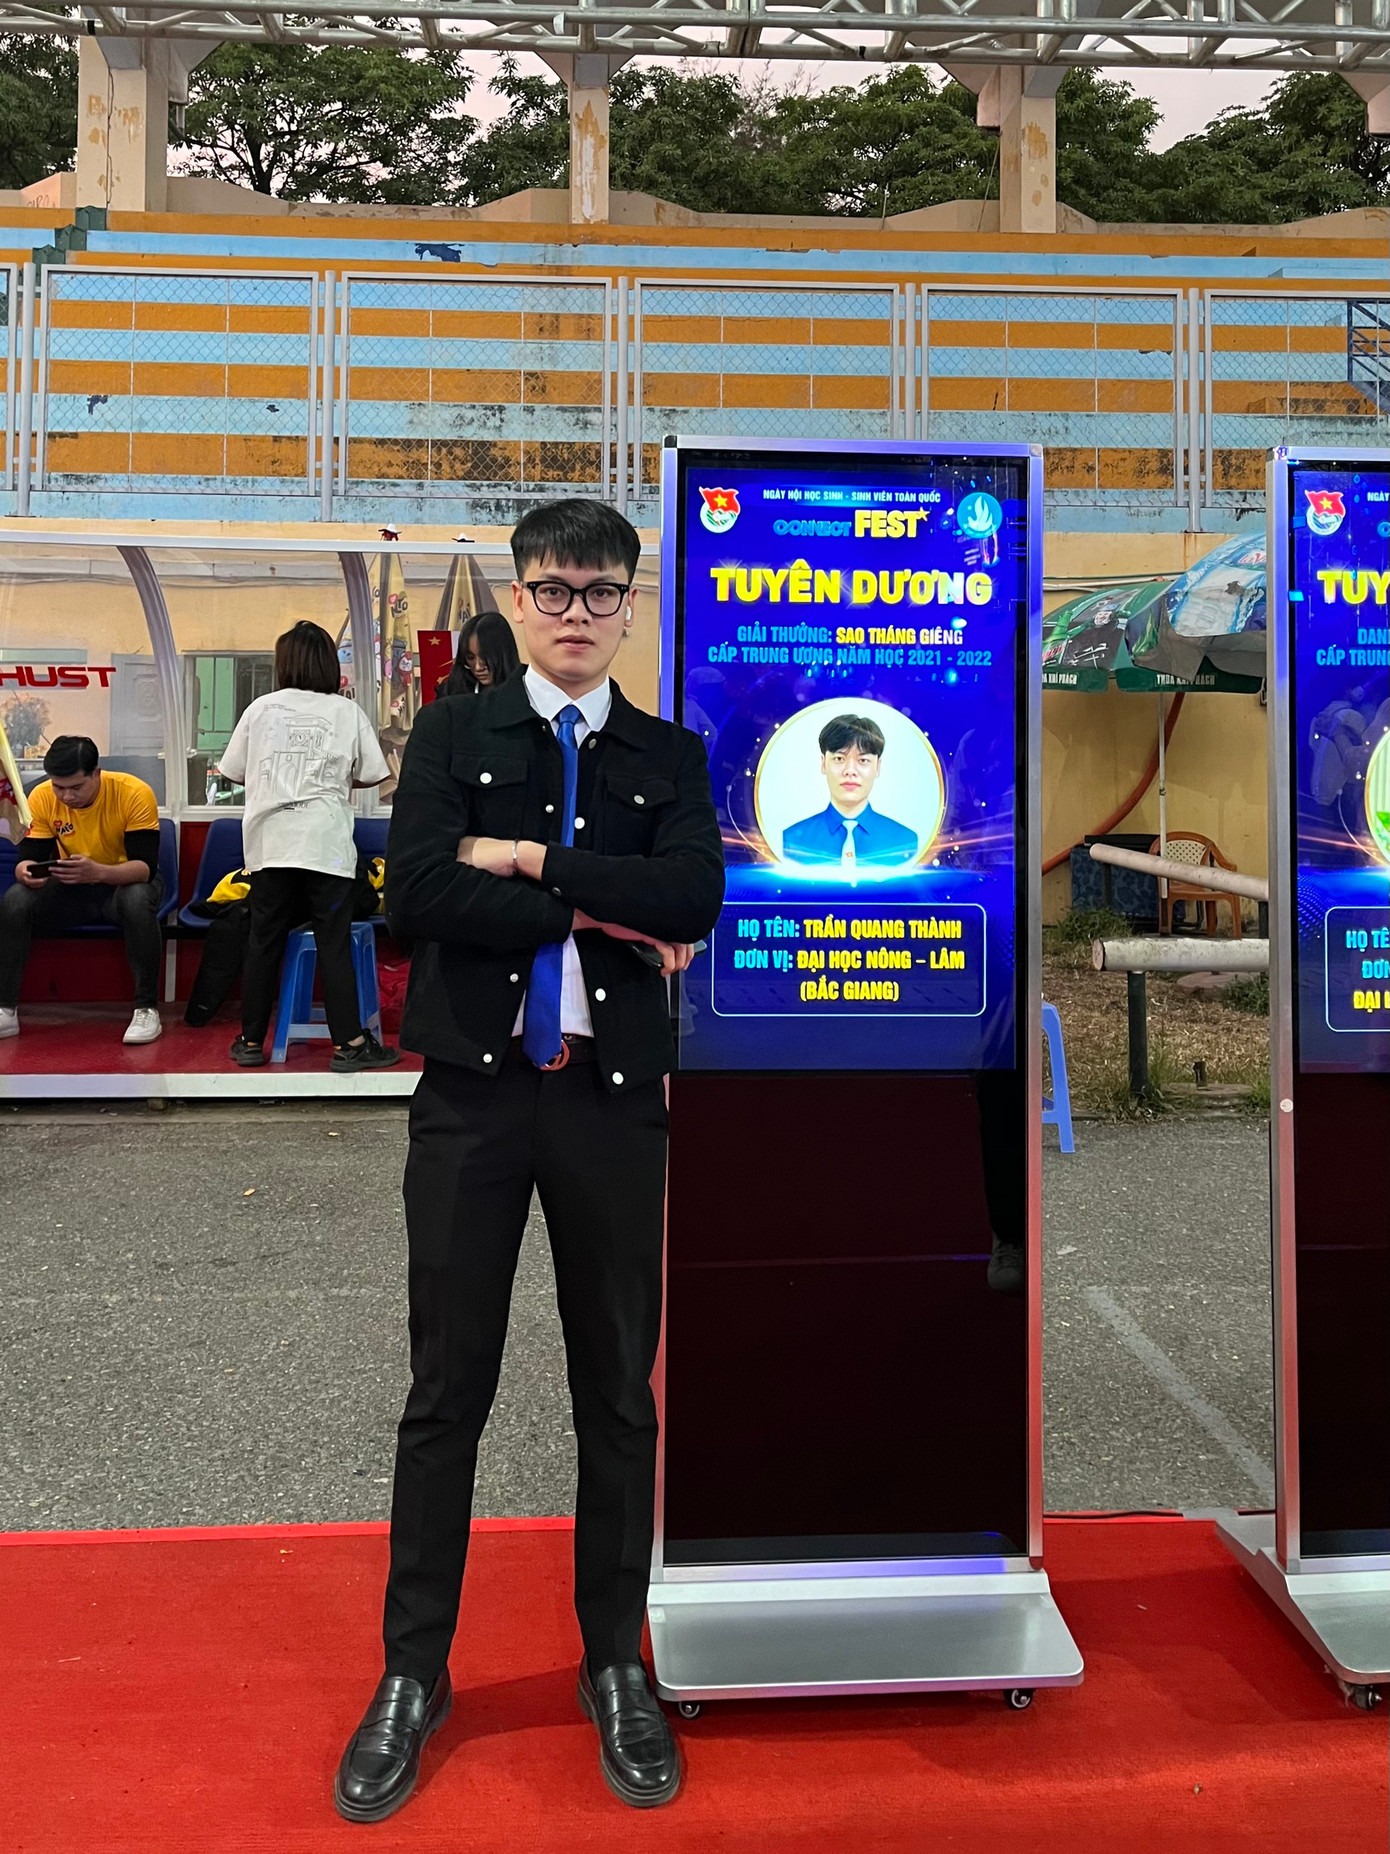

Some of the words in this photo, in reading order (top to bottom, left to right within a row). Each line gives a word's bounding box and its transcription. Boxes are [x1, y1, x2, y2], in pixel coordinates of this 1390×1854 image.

[763, 488, 786, 500] NGÀY
[787, 489, 802, 502] HỘI
[804, 491, 821, 502] HỌC
[823, 491, 843, 501] SINH
[851, 491, 872, 502] SINH
[873, 490, 893, 502] VIÊN
[894, 491, 917, 503] TOÀN
[918, 489, 941, 503] QUỐC
[1367, 490, 1390, 502] NGÀY
[854, 509, 924, 538] FEST
[710, 559, 841, 604] TUYÊN
[853, 568, 994, 605] DƯƠNG
[737, 621, 767, 644] GIẢI
[771, 621, 832, 645] THƯỞNG:
[836, 627, 865, 645] SAO
[868, 624, 917, 646] THÁNG
[919, 625, 964, 646] GIÊNG
[1358, 628, 1390, 646] DAN
[708, 641, 738, 663] CẤP
[741, 646, 789, 664] TRUNG
[793, 646, 833, 665] ƯƠNG
[838, 645, 872, 666] NĂM
[875, 649, 904, 668] HỌC
[908, 650, 942, 666] 2021
[956, 651, 992, 667] 2022
[1316, 644, 1346, 666] CẤP
[737, 918, 760, 942] HỌ
[764, 915, 800, 938] TÊN:
[803, 913, 847, 939] TRẦN
[850, 919, 905, 941] QUANG
[908, 916, 962, 939] THÀNH
[1346, 930, 1368, 952] HỌ
[734, 948, 769, 969] ĐƠN
[772, 950, 794, 973] VỊ:
[797, 950, 825, 973] ĐẠI
[829, 950, 862, 974] HỌC
[866, 946, 912, 970] NÔNG
[930, 946, 965, 970] LÂM
[800, 974, 840, 1002] (BẮC
[843, 981, 900, 1002] GIANG)
[1353, 990, 1381, 1013] ĐẠI
